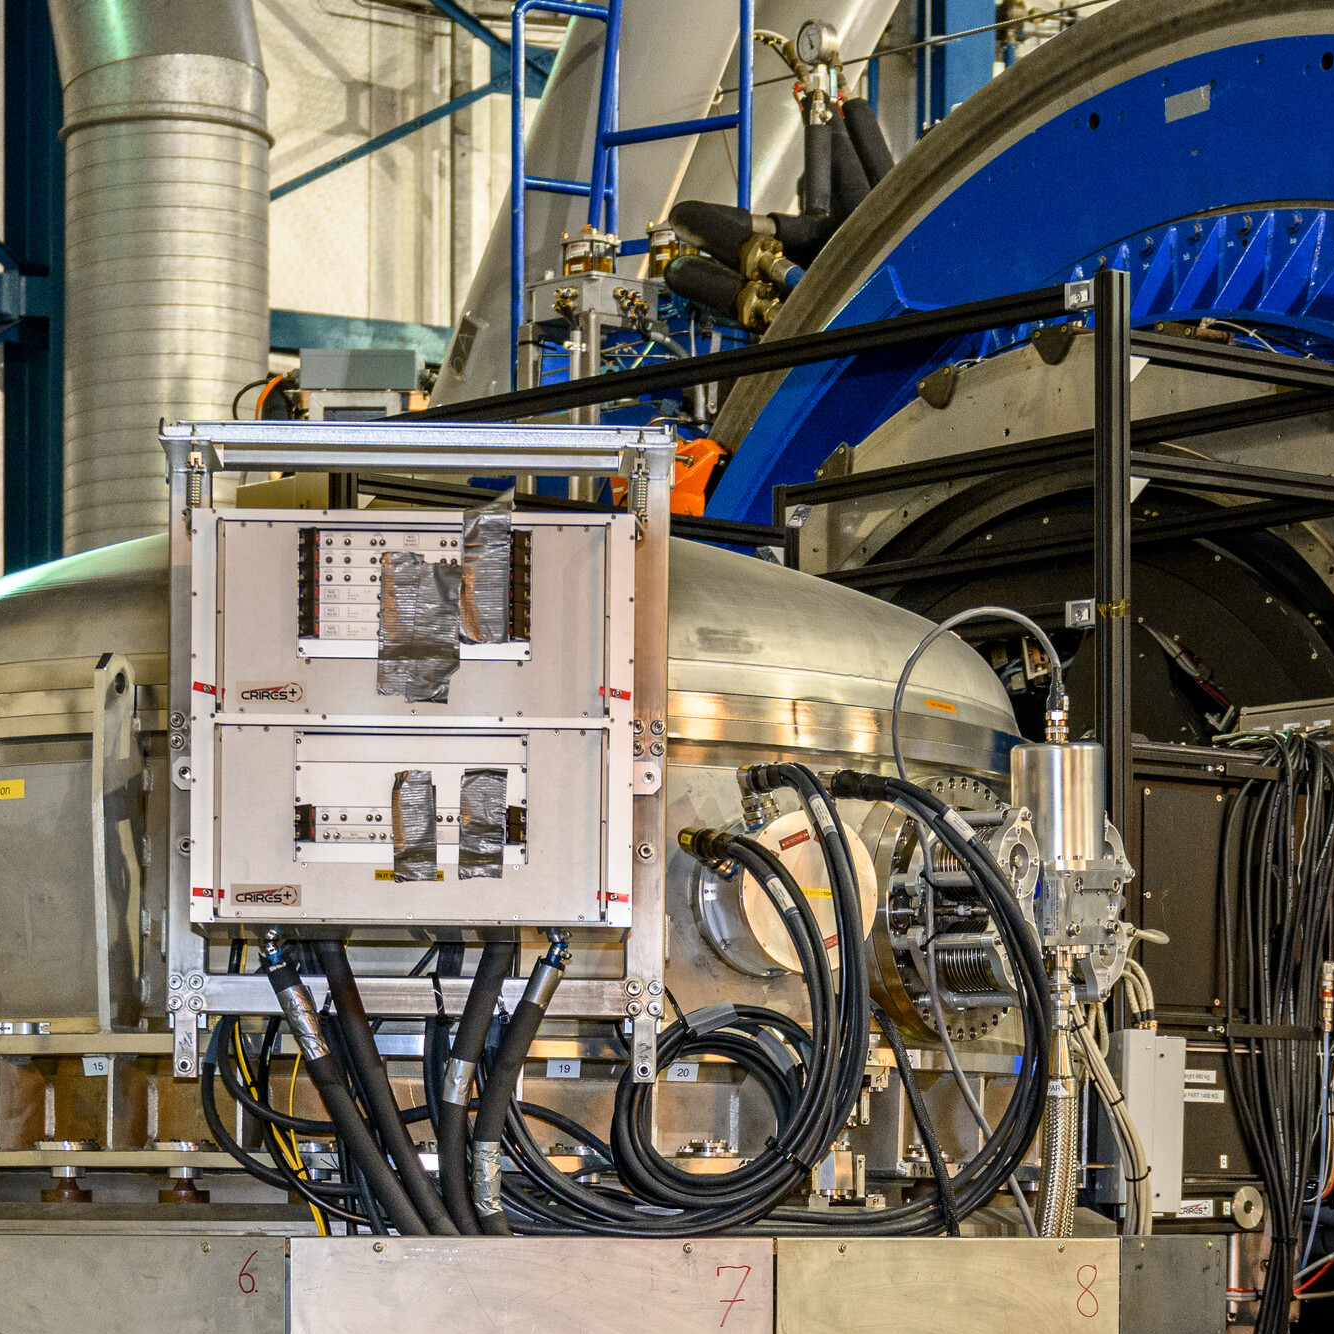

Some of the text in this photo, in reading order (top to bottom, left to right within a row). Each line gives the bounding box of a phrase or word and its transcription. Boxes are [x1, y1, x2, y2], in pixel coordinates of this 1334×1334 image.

[93, 1062, 104, 1071] 15
[558, 1064, 571, 1074] 19
[677, 1067, 689, 1077] 20
[1077, 1264, 1099, 1317] 8
[717, 1265, 751, 1327] 7
